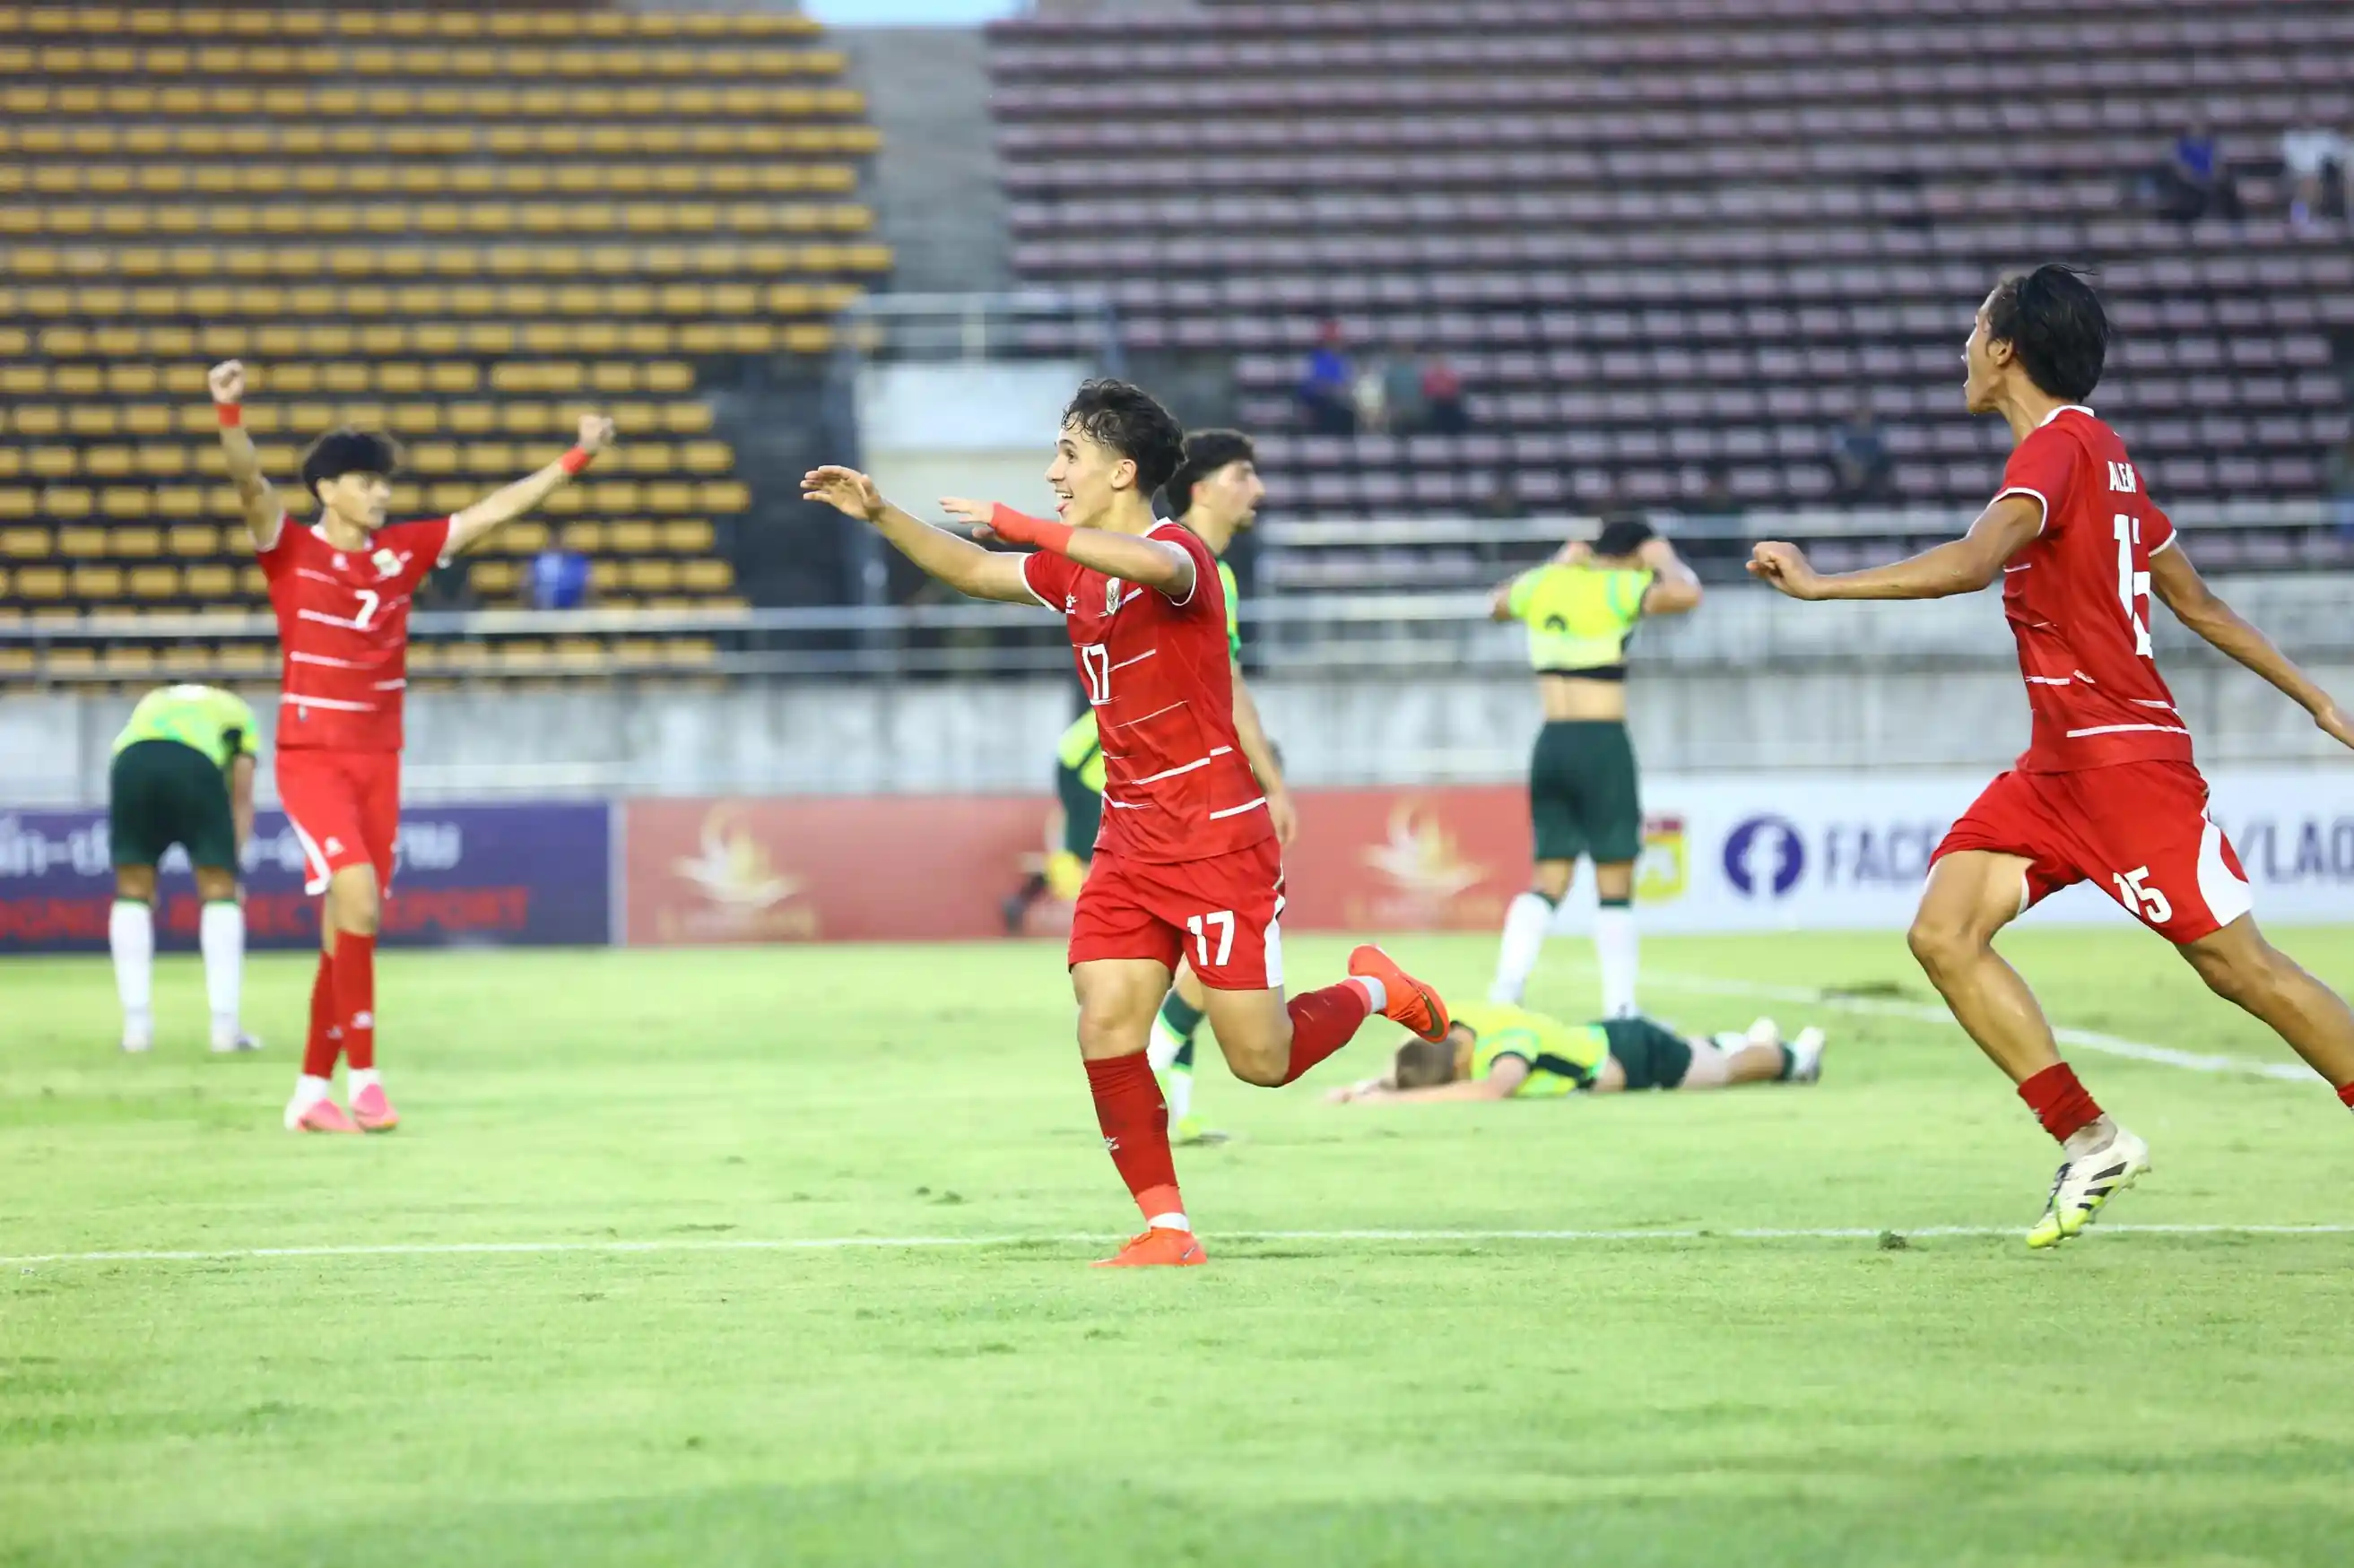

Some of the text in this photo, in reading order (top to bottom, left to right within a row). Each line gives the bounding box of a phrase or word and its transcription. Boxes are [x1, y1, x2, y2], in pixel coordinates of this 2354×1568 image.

[354, 589, 379, 628] 7
[1081, 643, 1109, 699] 17
[2113, 865, 2173, 923] 15
[1186, 910, 1235, 966] 17
